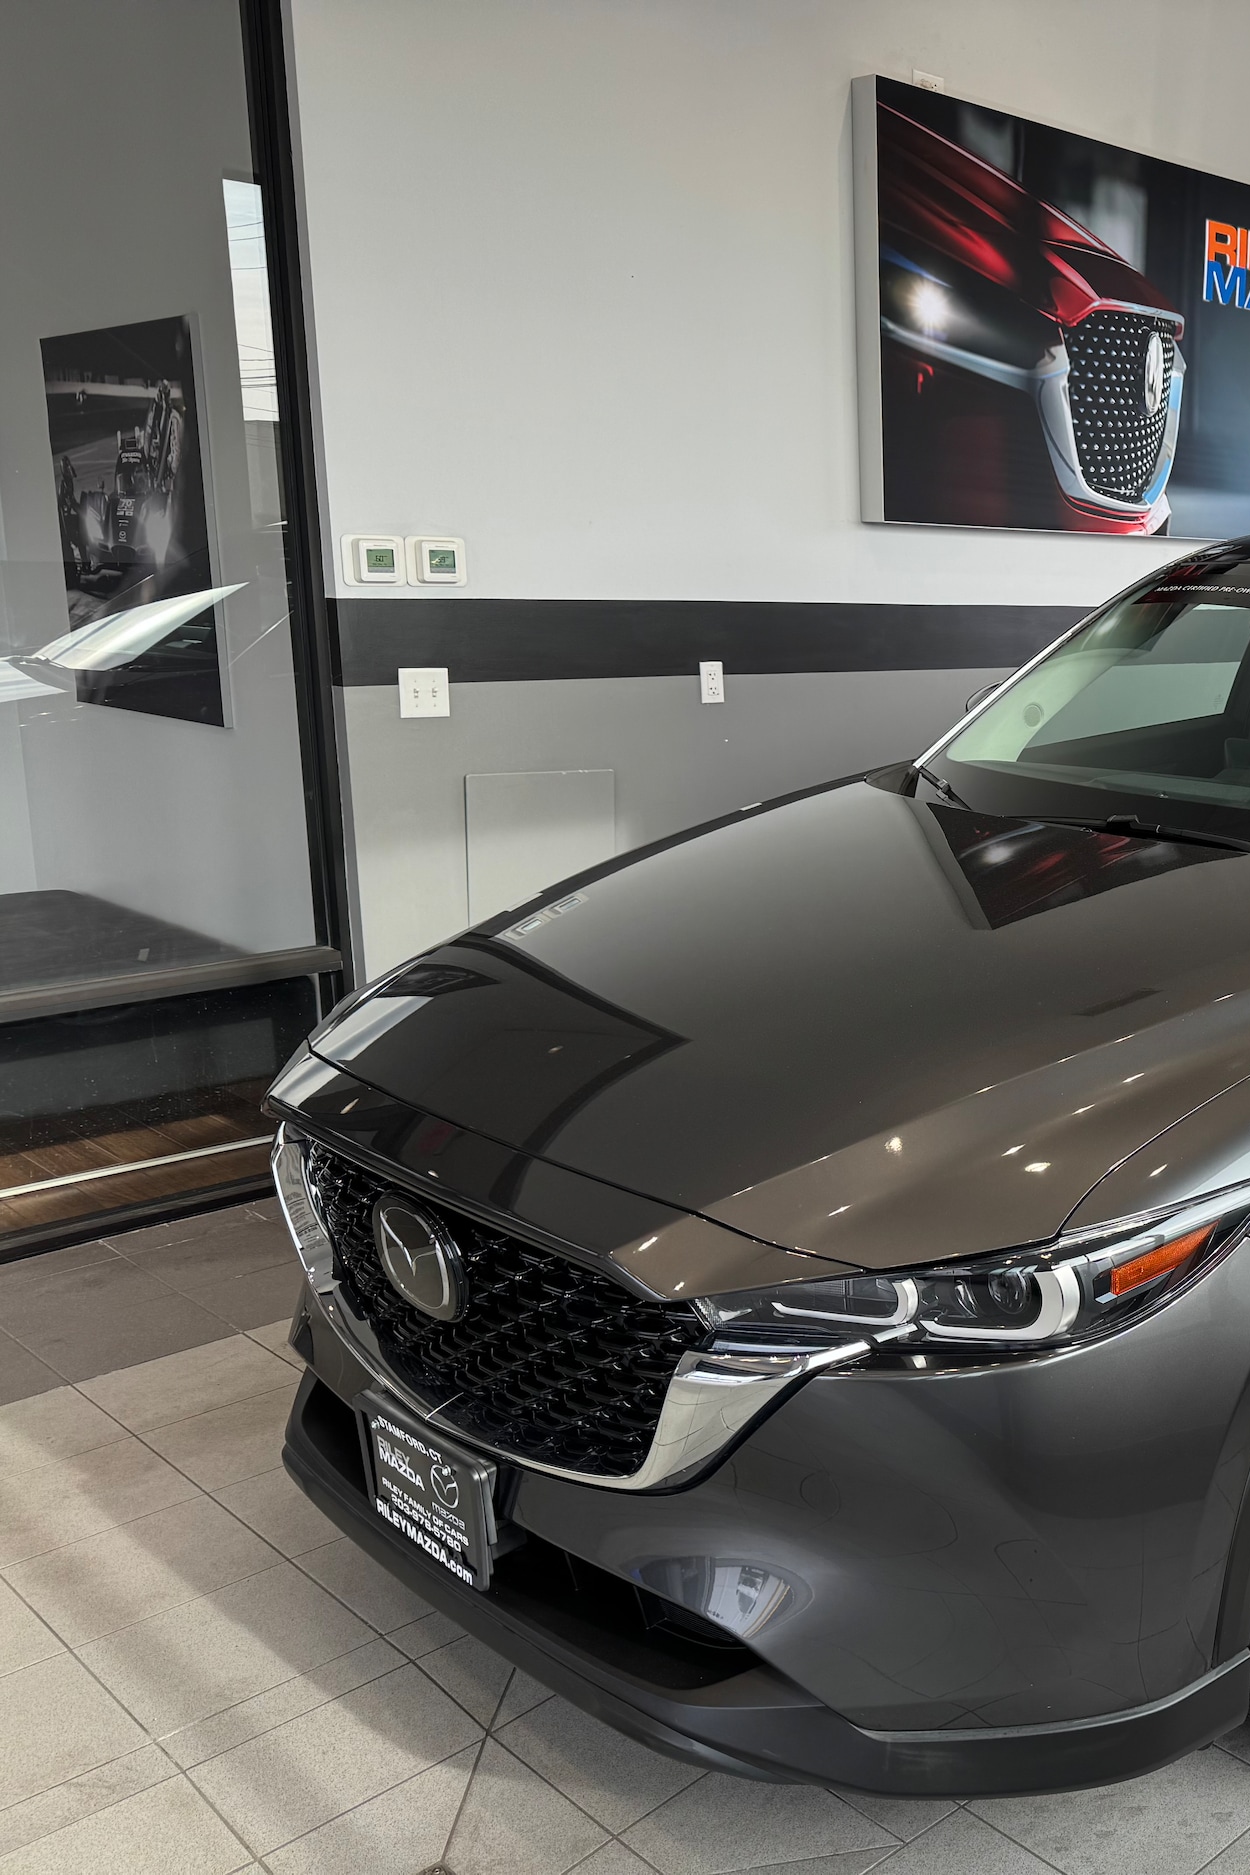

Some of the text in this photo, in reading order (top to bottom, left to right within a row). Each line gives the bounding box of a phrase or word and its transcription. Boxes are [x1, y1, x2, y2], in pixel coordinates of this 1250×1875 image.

[377, 1415, 442, 1465] STAMFORD, CT
[377, 1435, 410, 1467] RILEY
[378, 1446, 425, 1491] MAZDA
[382, 1476, 469, 1547] RILEY FAMILY OF CARS
[376, 1497, 473, 1586] RILEYMAZDA.com
